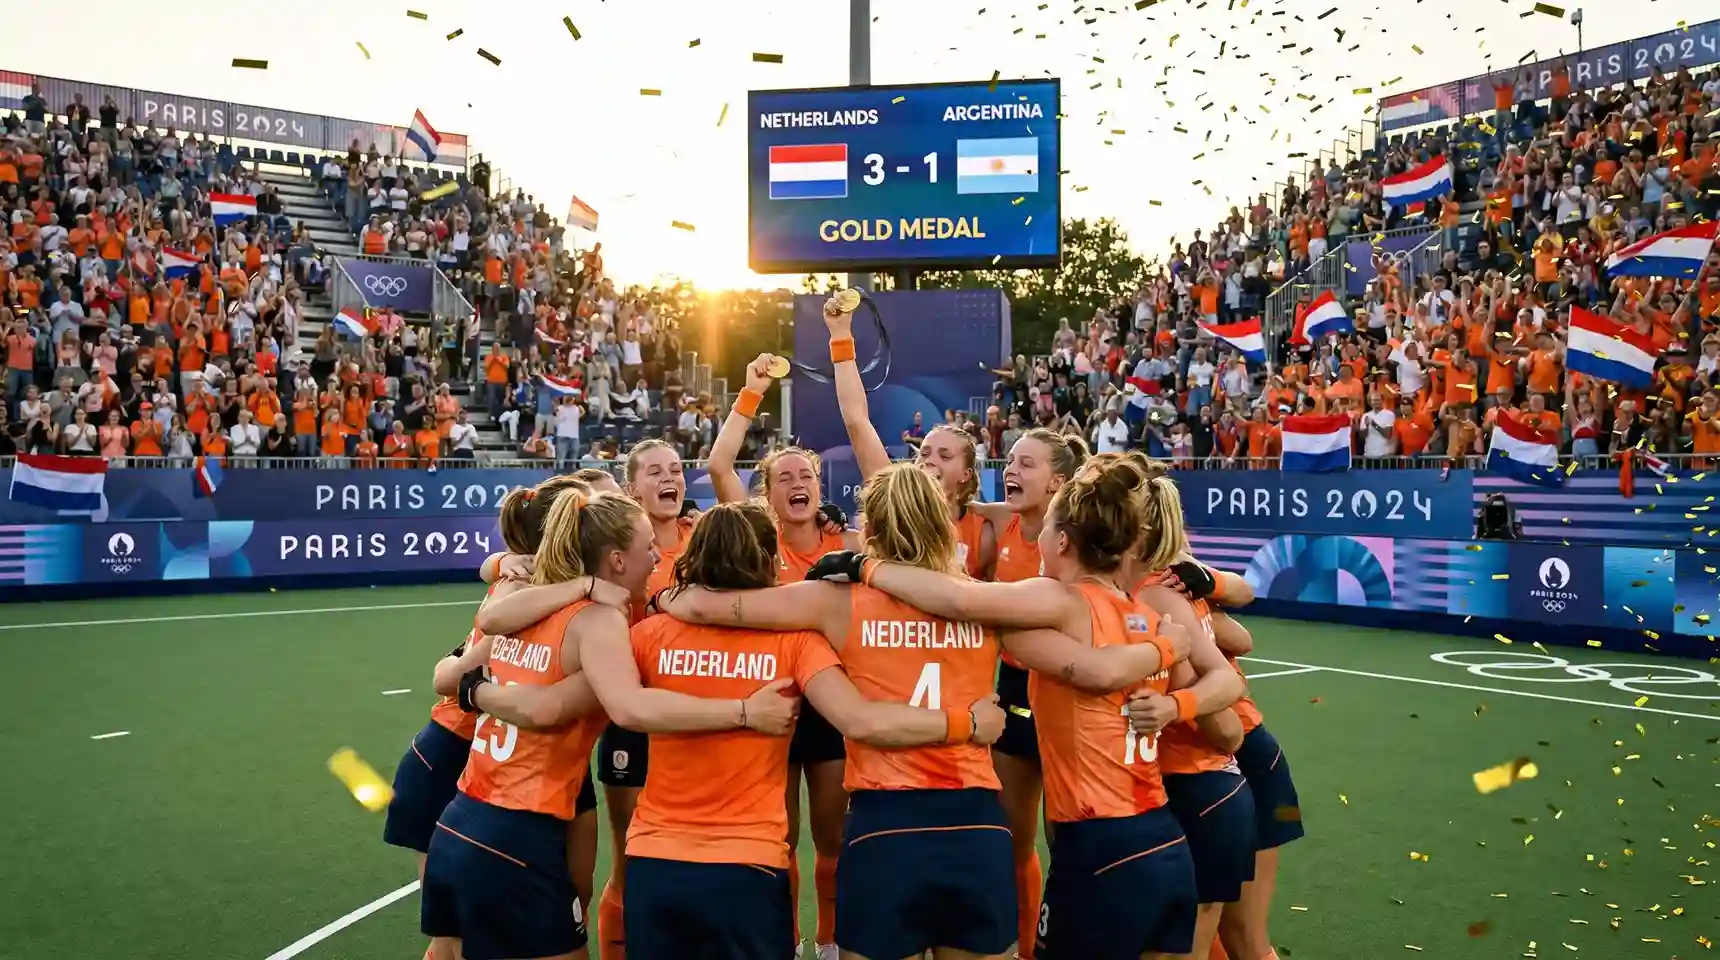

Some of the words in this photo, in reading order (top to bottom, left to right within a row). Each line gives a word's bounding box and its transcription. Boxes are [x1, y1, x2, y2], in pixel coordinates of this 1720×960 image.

[1635, 34, 1716, 69] 2024
[236, 113, 304, 138] 2024
[760, 109, 879, 129] NETHERLANDS
[942, 103, 1043, 122] ARGENTINA
[863, 153, 885, 186] 3
[923, 151, 939, 183] 1
[819, 219, 893, 243] GOLD
[900, 216, 986, 240] MEDAL
[441, 484, 523, 509] 202
[1326, 489, 1431, 521] 2024
[403, 531, 490, 555] 2024
[861, 619, 984, 649] NEDERLAND
[490, 634, 552, 673] EDERLAND
[658, 648, 777, 681] NEDERLAND
[908, 662, 941, 710] 4
